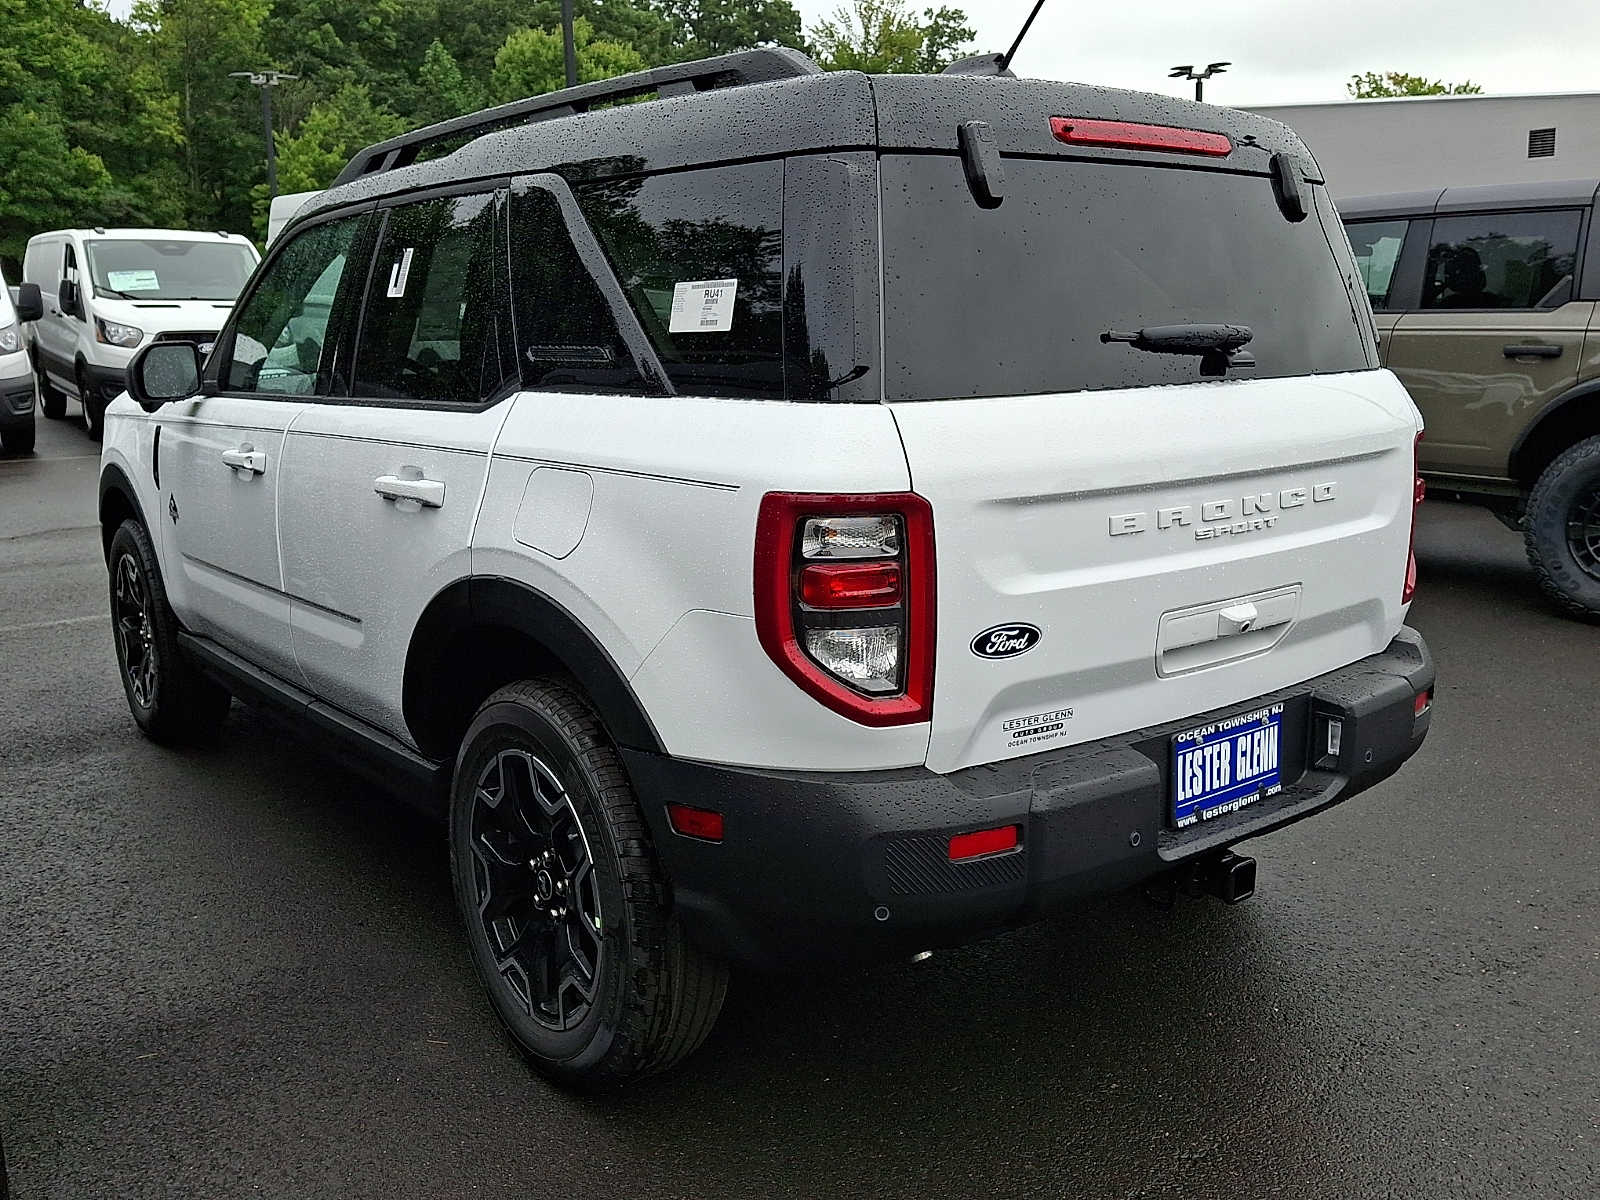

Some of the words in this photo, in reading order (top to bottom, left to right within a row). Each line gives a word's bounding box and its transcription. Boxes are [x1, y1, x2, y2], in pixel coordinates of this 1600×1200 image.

[704, 289, 723, 298] RU41
[1109, 482, 1337, 536] BRONCO
[1195, 515, 1279, 540] SPORT
[986, 629, 1029, 653] Ford
[1002, 717, 1039, 730] LESTER
[1042, 709, 1073, 721] GLENN
[1177, 726, 1215, 742] OCEAN
[1218, 711, 1269, 731] TOWNSHIP
[1272, 703, 1283, 716] NJ
[1177, 741, 1231, 801] LESTER
[1236, 725, 1278, 781] GLENN
